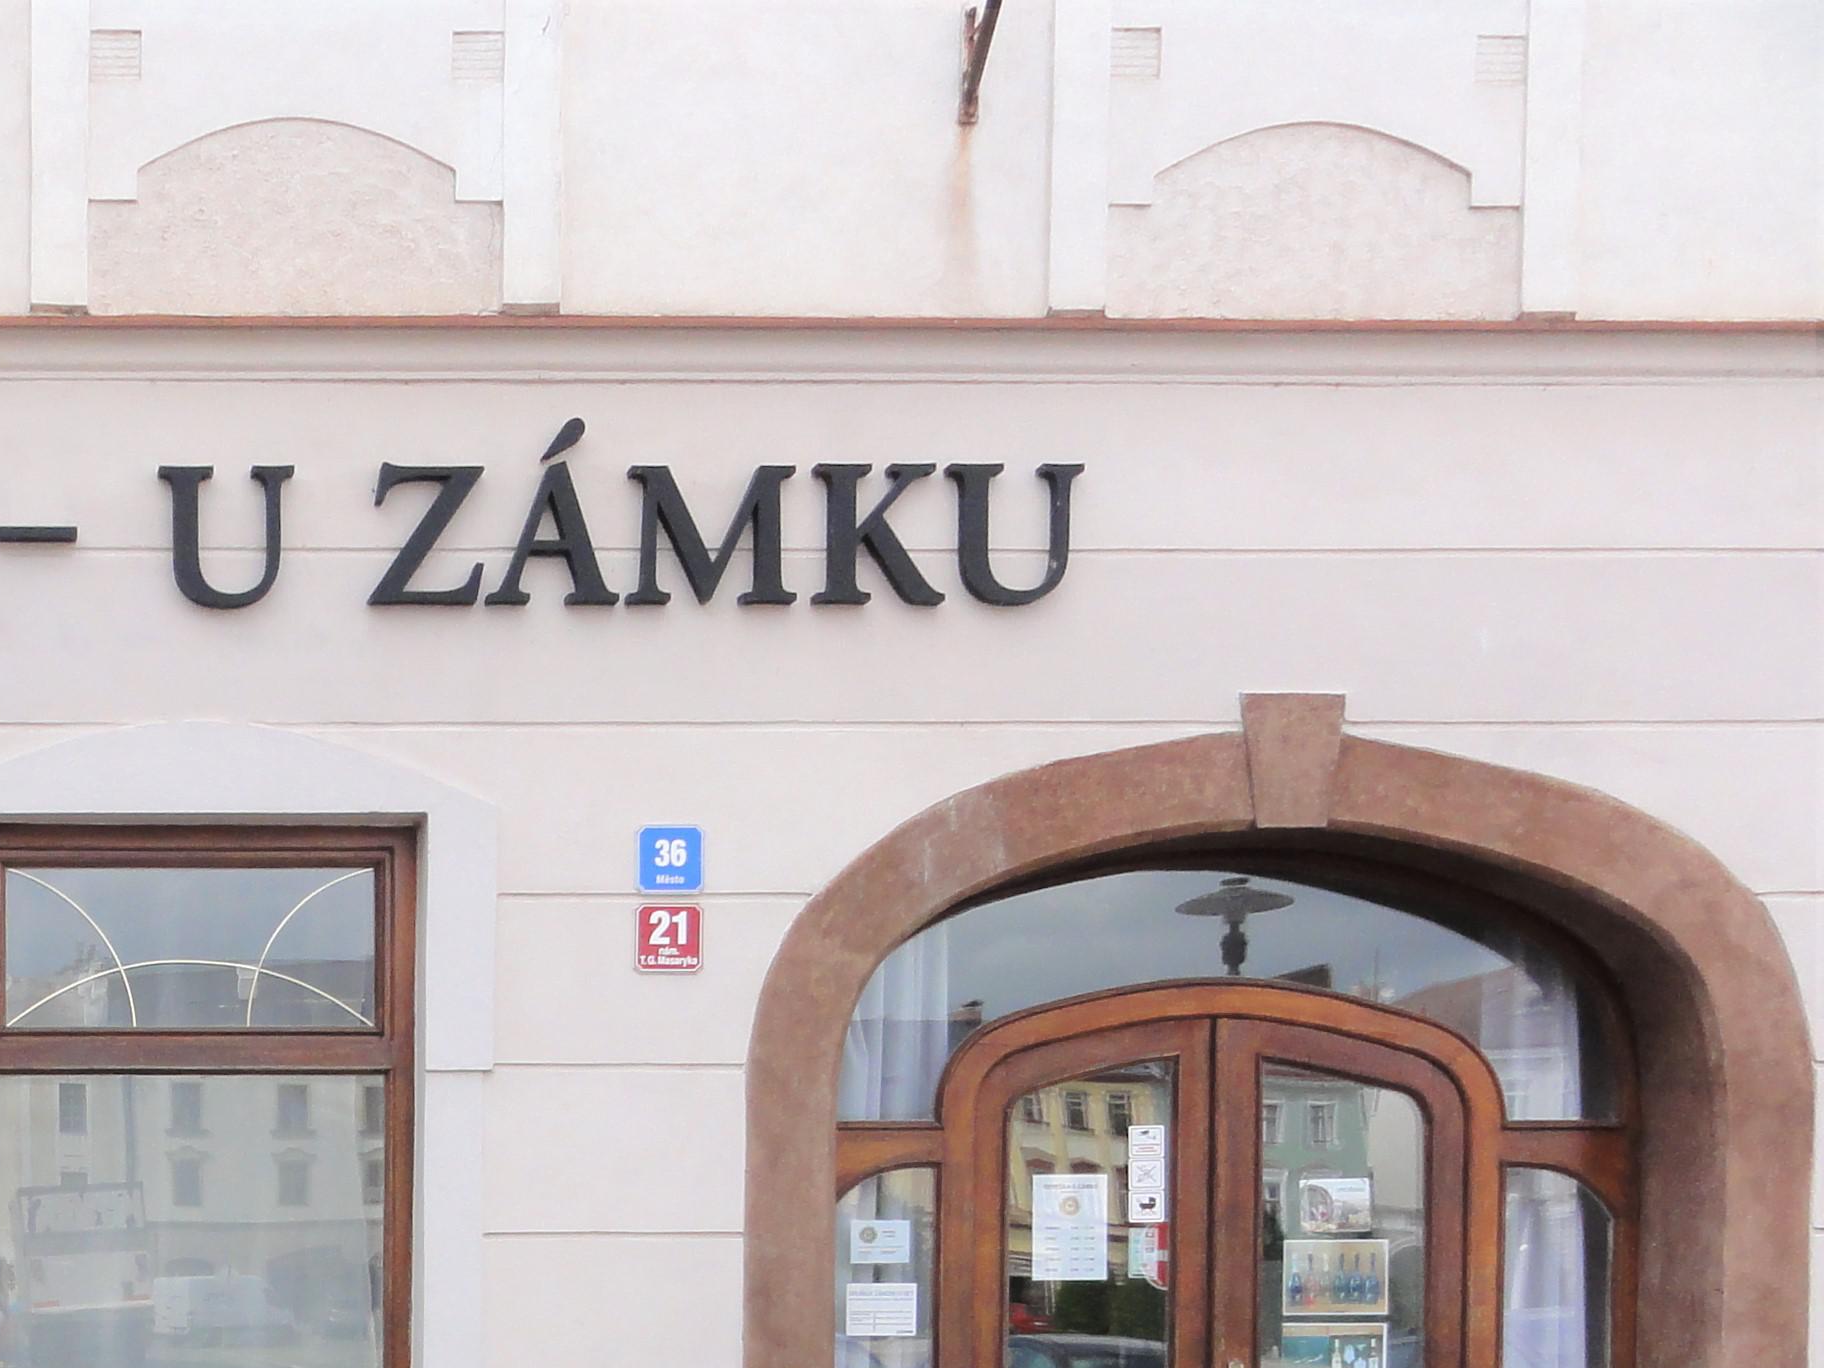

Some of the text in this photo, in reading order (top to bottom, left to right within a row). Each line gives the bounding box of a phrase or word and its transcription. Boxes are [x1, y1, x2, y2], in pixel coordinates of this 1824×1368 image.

[157, 464, 295, 610] U
[366, 417, 1085, 609] ZÁMKU
[654, 838, 687, 868] 36
[648, 909, 688, 946] 21
